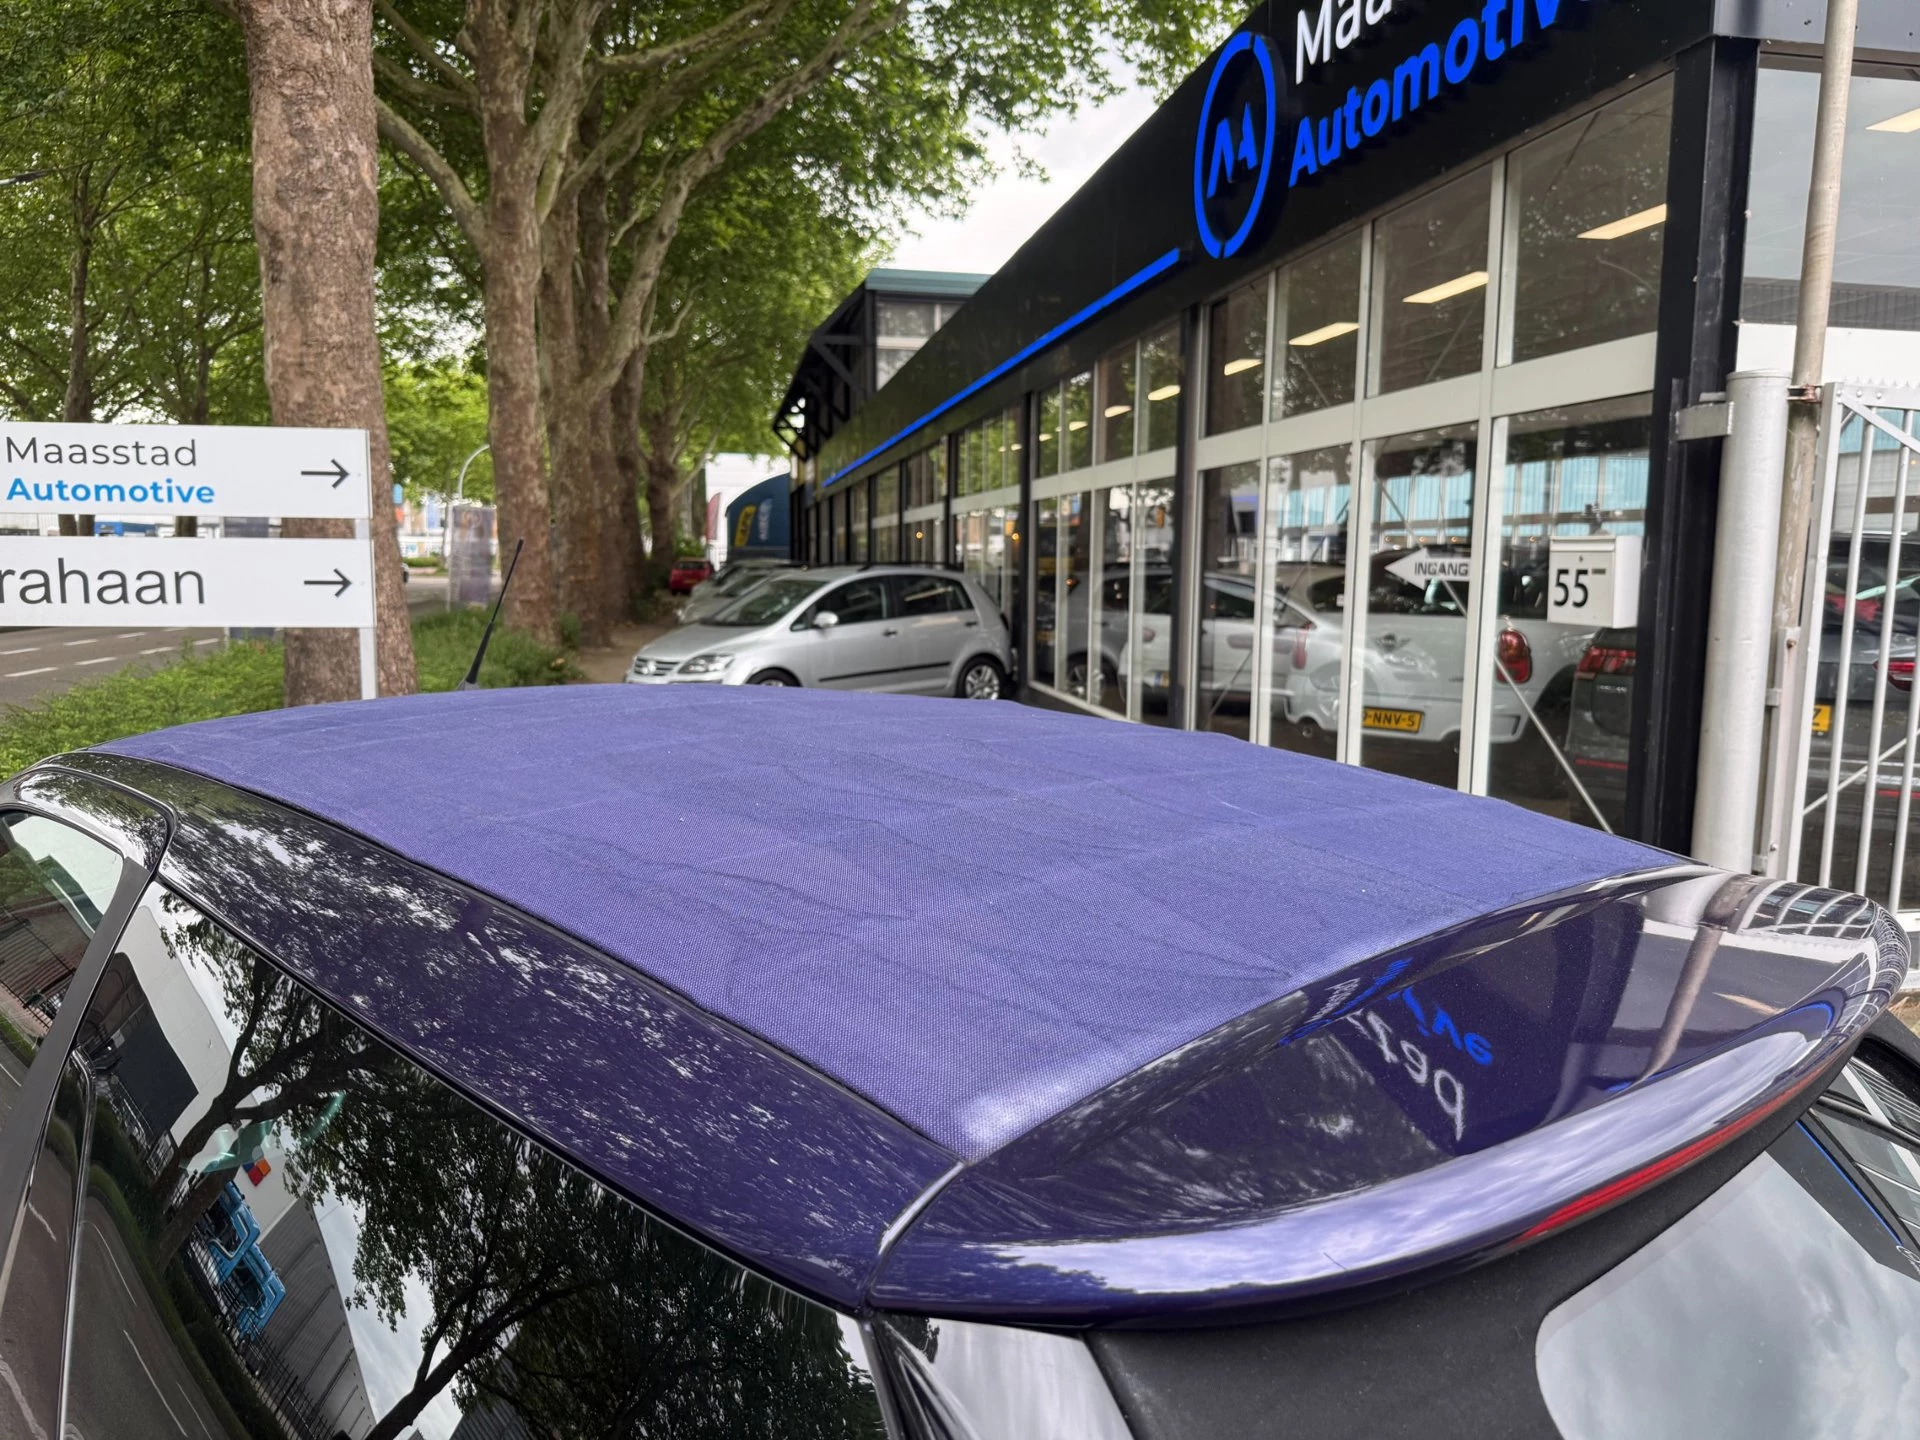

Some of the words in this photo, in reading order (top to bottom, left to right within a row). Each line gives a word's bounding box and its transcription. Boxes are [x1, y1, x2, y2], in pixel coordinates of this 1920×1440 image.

[6, 436, 197, 466] Maasstad
[6, 478, 215, 503] Automotive
[1414, 562, 1469, 577] INGANG
[1553, 568, 1589, 608] 55
